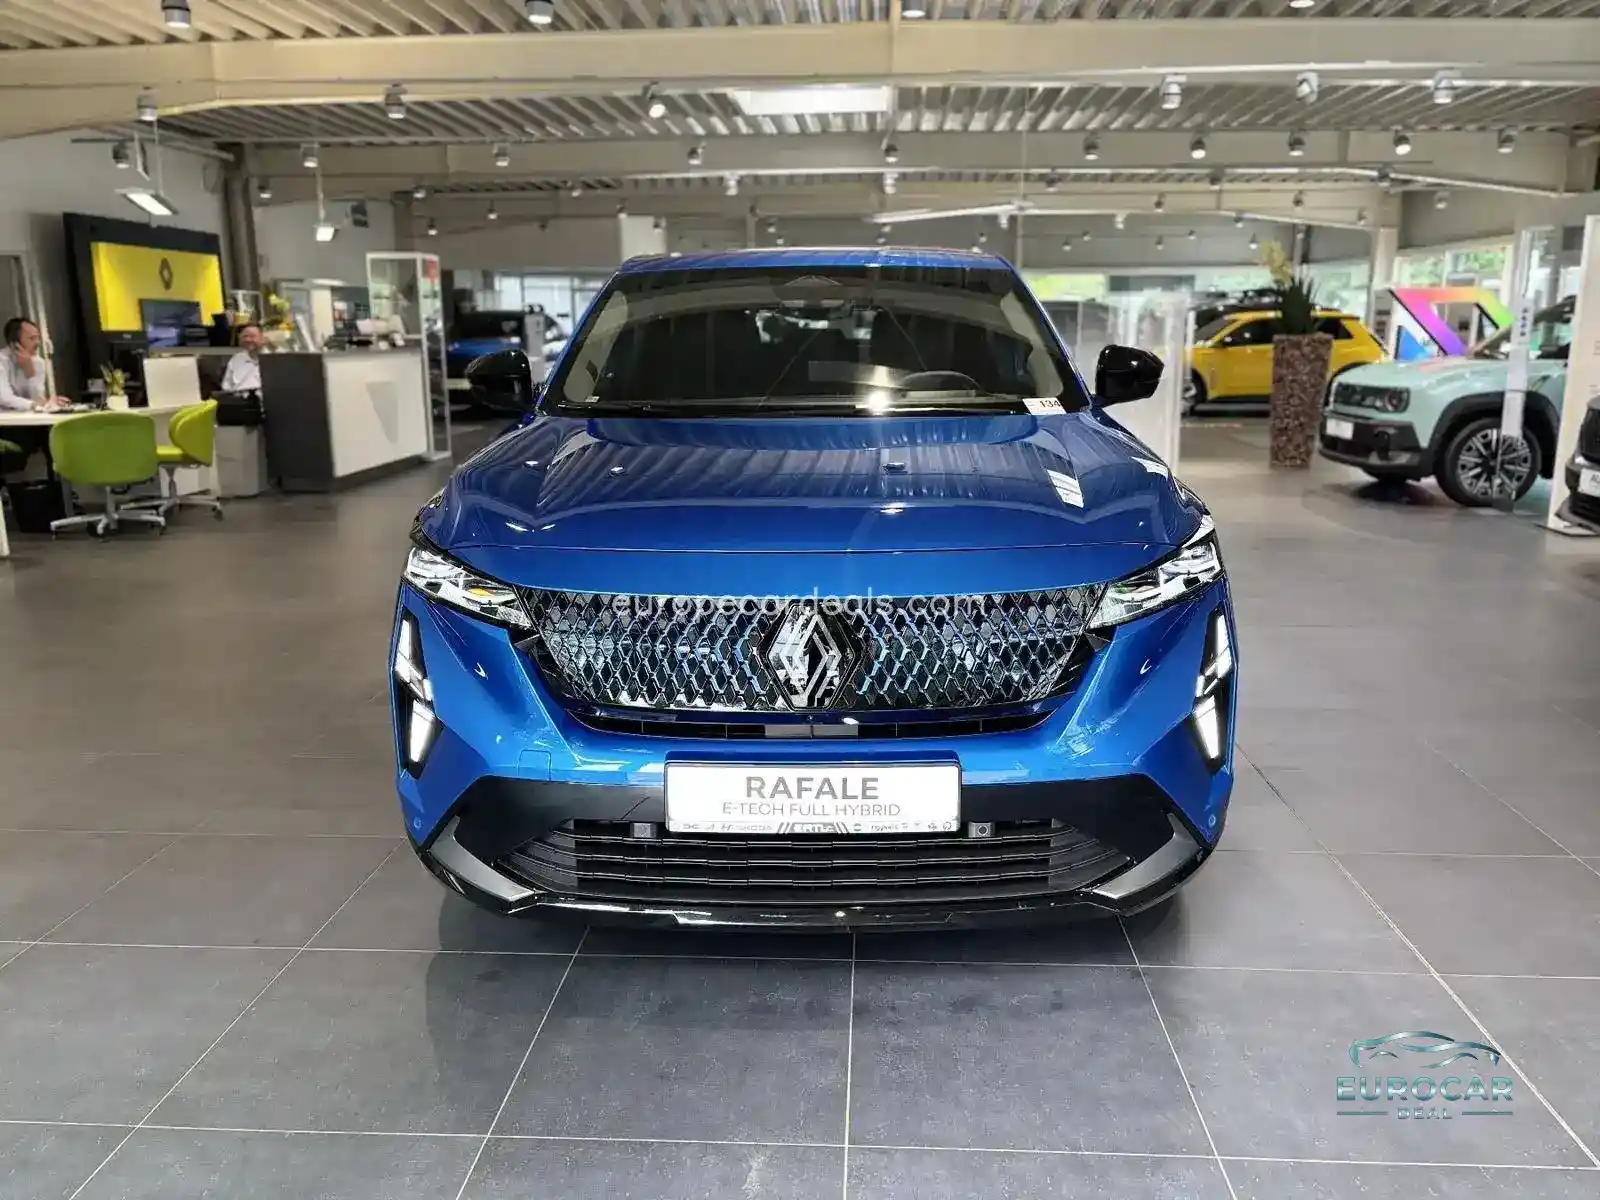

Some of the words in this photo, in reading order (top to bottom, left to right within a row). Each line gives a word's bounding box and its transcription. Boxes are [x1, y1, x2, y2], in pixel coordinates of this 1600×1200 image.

[746, 776, 879, 800] RAFALE
[722, 801, 783, 816] E-TECH
[789, 803, 830, 816] FULL
[835, 803, 901, 817] HYBRID
